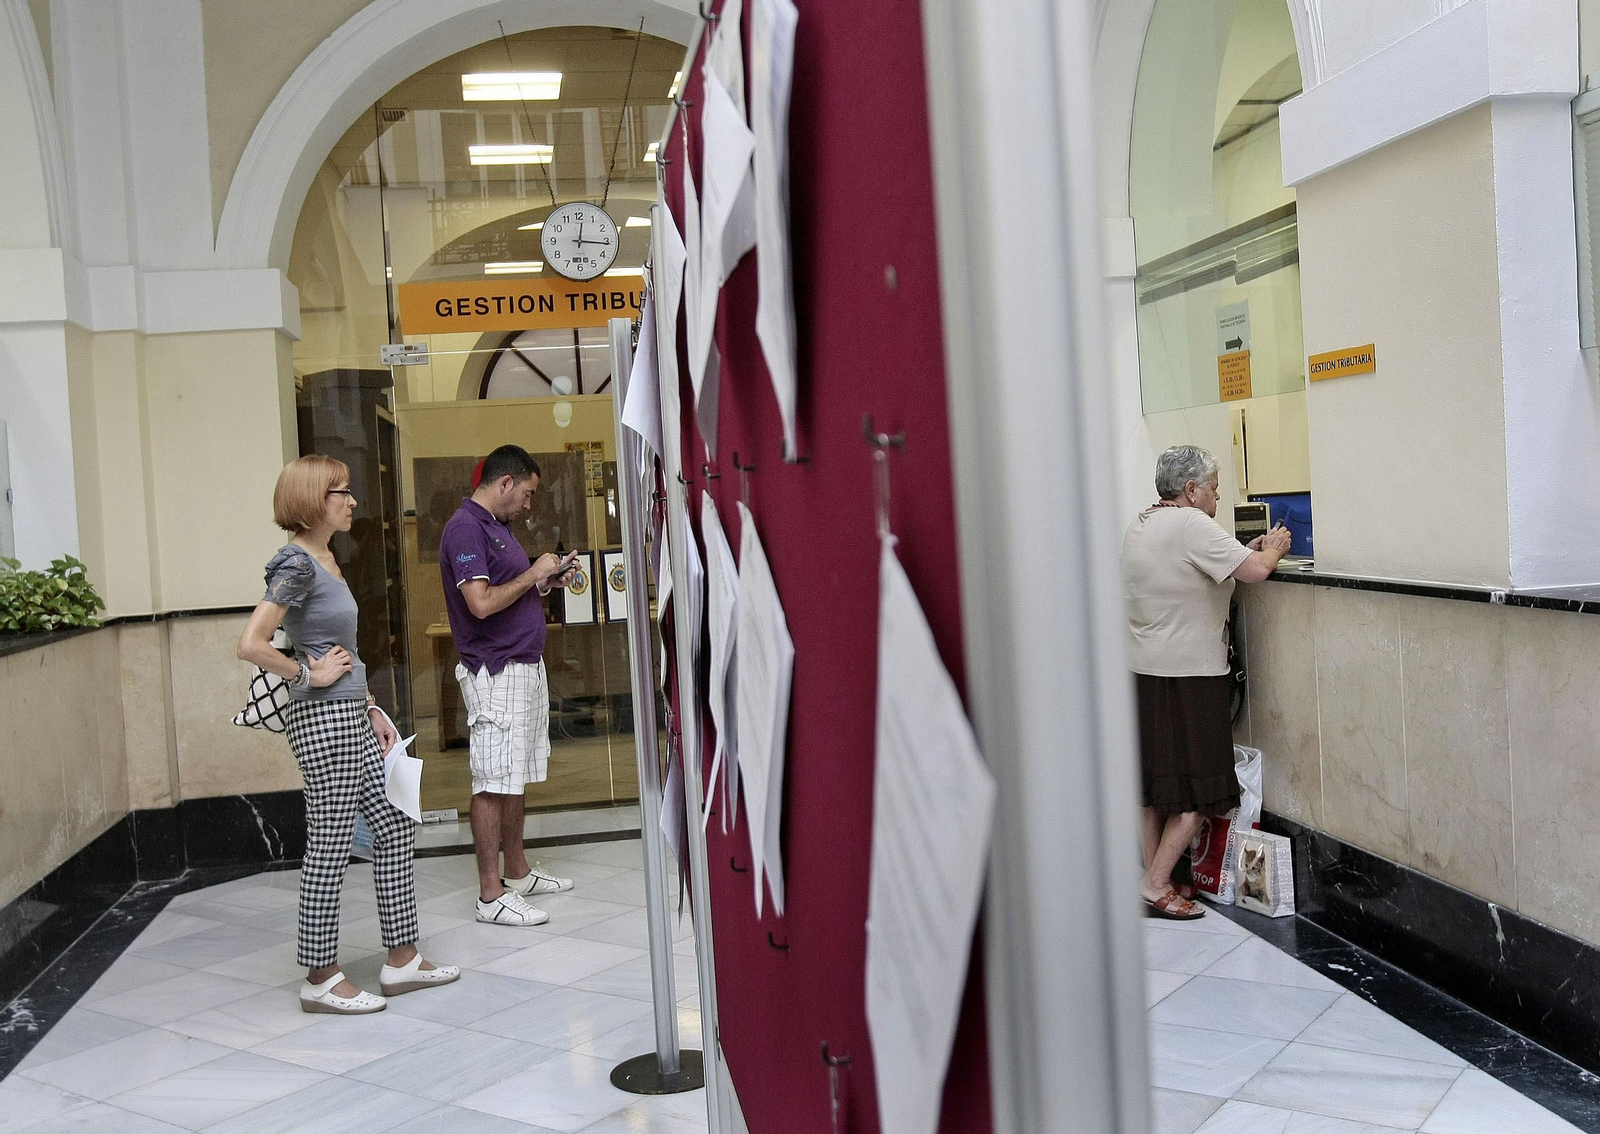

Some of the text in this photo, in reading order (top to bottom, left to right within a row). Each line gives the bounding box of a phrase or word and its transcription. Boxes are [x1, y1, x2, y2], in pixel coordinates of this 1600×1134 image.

[562, 215, 570, 223] 11
[574, 211, 584, 221] 12
[590, 215, 595, 223] 1
[553, 224, 563, 233] 10
[599, 223, 606, 232] 2
[550, 236, 557, 245] 9
[603, 237, 610, 245] 3
[554, 250, 561, 259] 8
[599, 250, 606, 259] 4
[564, 259, 571, 268] 7
[577, 263, 584, 272] 6
[590, 259, 597, 268] 5
[435, 294, 554, 317] GESTION
[1310, 353, 1372, 373] GESTION TRIBUTARIA
[1193, 871, 1214, 886] STOP
